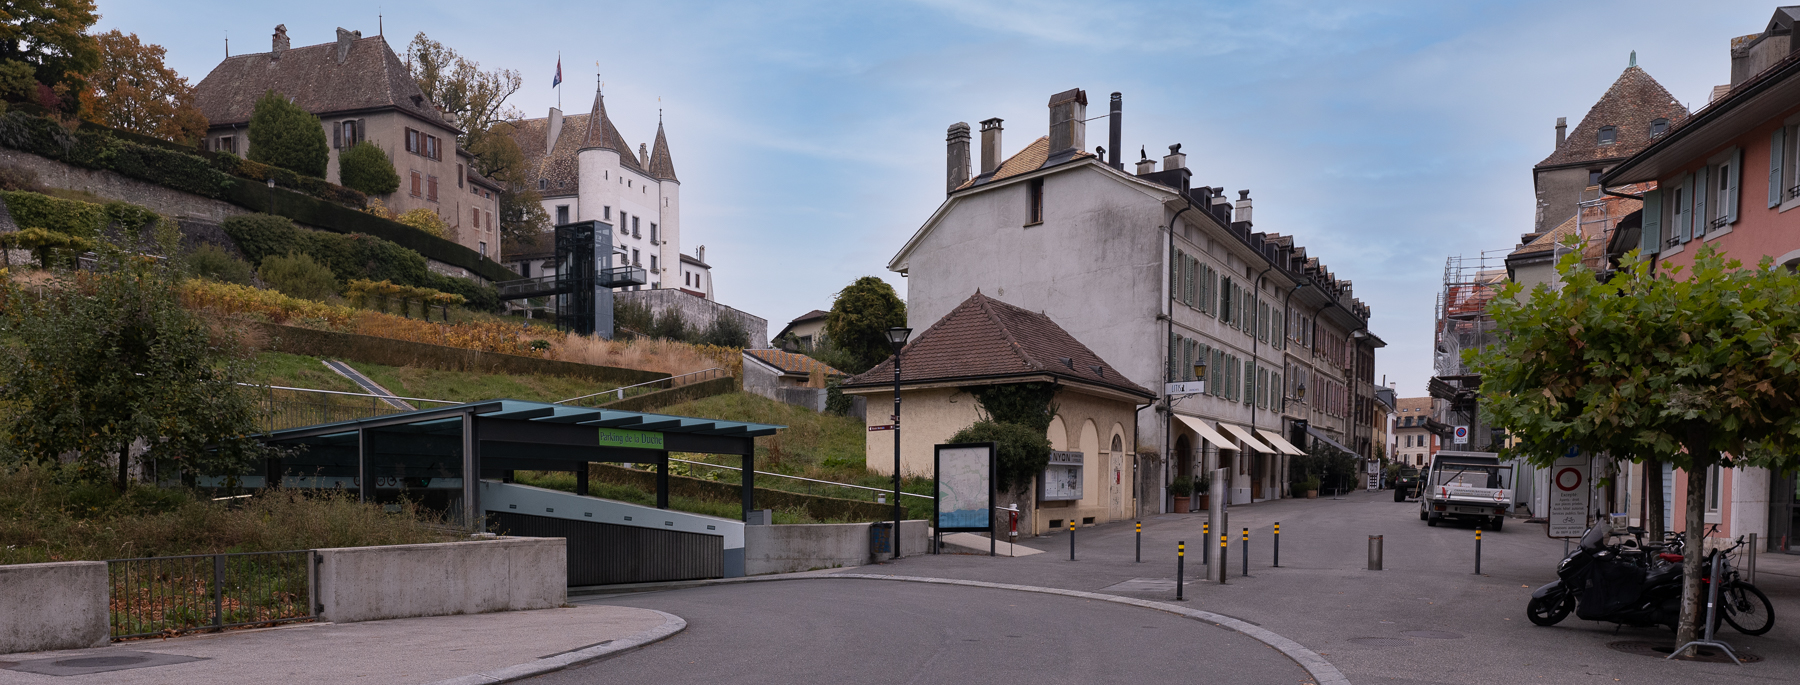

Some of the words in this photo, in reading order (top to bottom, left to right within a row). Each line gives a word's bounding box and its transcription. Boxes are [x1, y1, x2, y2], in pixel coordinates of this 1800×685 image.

[600, 432, 623, 444] Parking
[625, 434, 632, 443] de
[634, 434, 639, 443] la
[642, 434, 662, 444] Duche
[1053, 453, 1070, 461] NYON
